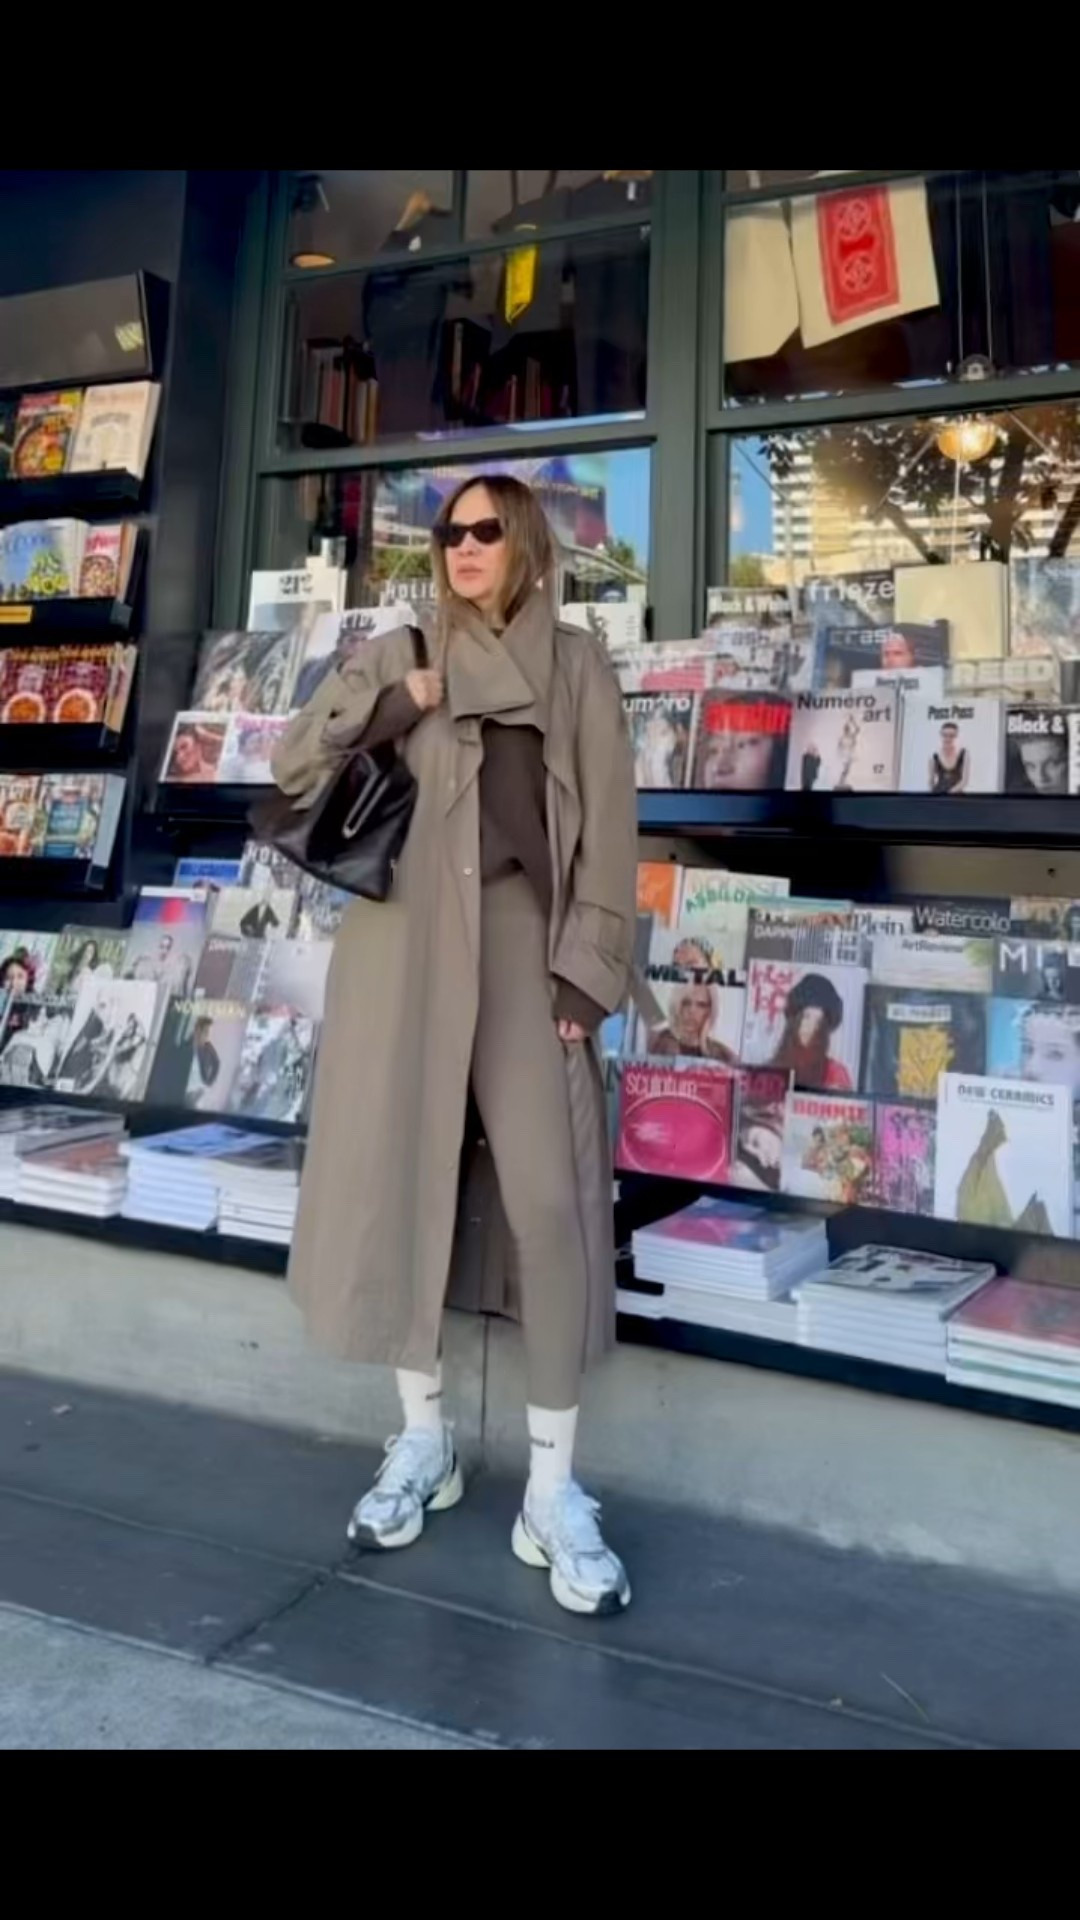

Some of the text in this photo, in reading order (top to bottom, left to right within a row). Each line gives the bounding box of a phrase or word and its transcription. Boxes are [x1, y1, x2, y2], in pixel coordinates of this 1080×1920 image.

[809, 578, 896, 601] frieze
[863, 705, 892, 722] art
[1007, 713, 1065, 735] Black &
[645, 963, 746, 987] METAL
